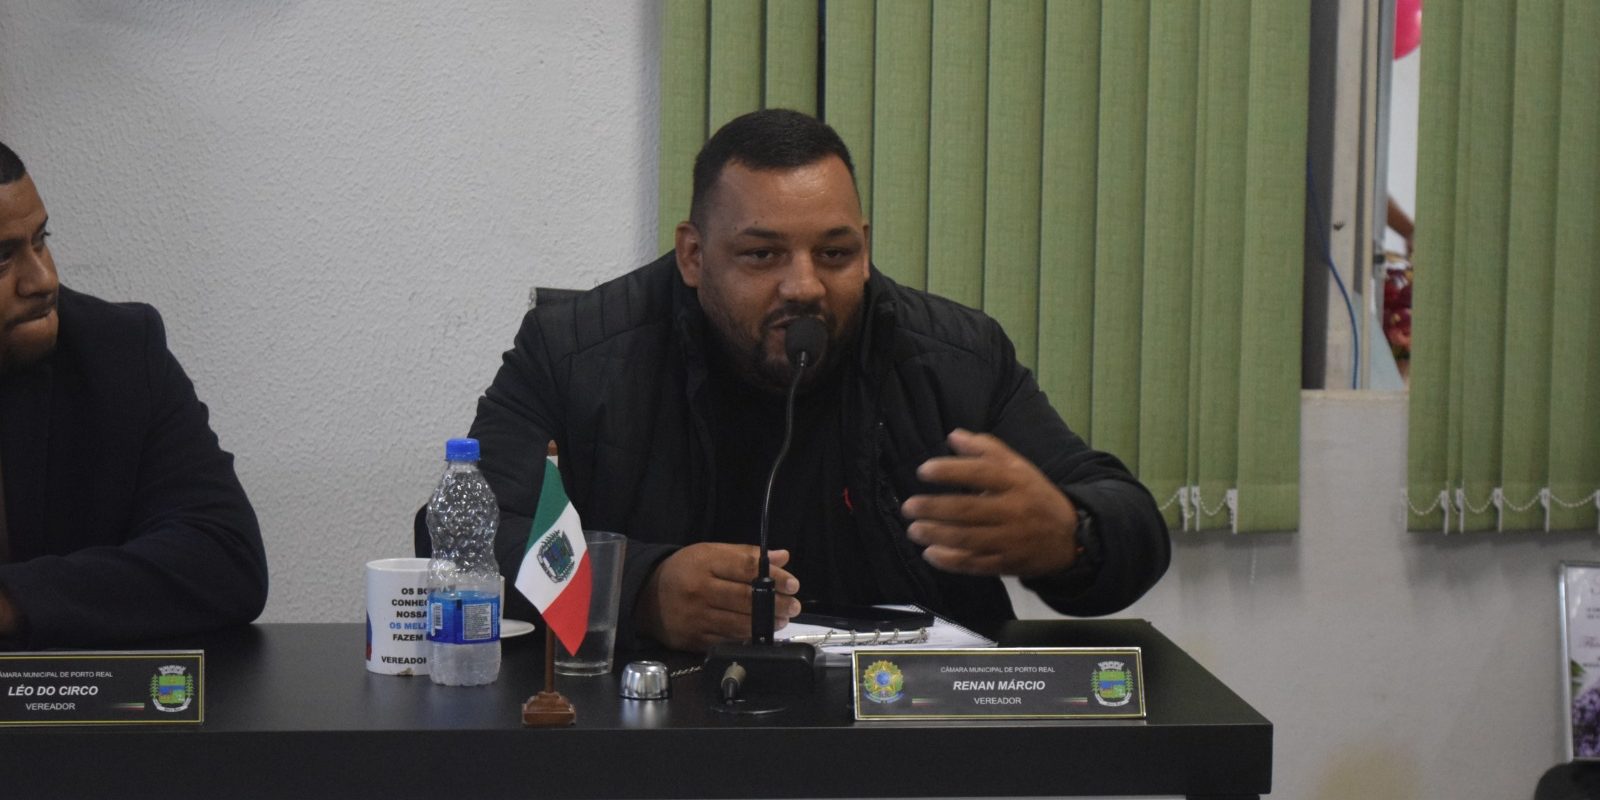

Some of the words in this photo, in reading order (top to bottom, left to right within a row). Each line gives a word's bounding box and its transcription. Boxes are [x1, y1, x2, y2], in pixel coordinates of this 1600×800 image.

[953, 681, 995, 690] RENAN
[997, 679, 1046, 690] MÁRCIO
[8, 684, 34, 696] LÉO
[36, 686, 56, 696] DO
[59, 686, 99, 696] CIRCO
[974, 697, 1022, 705] VEREADOR
[25, 703, 76, 711] VEREADOR
